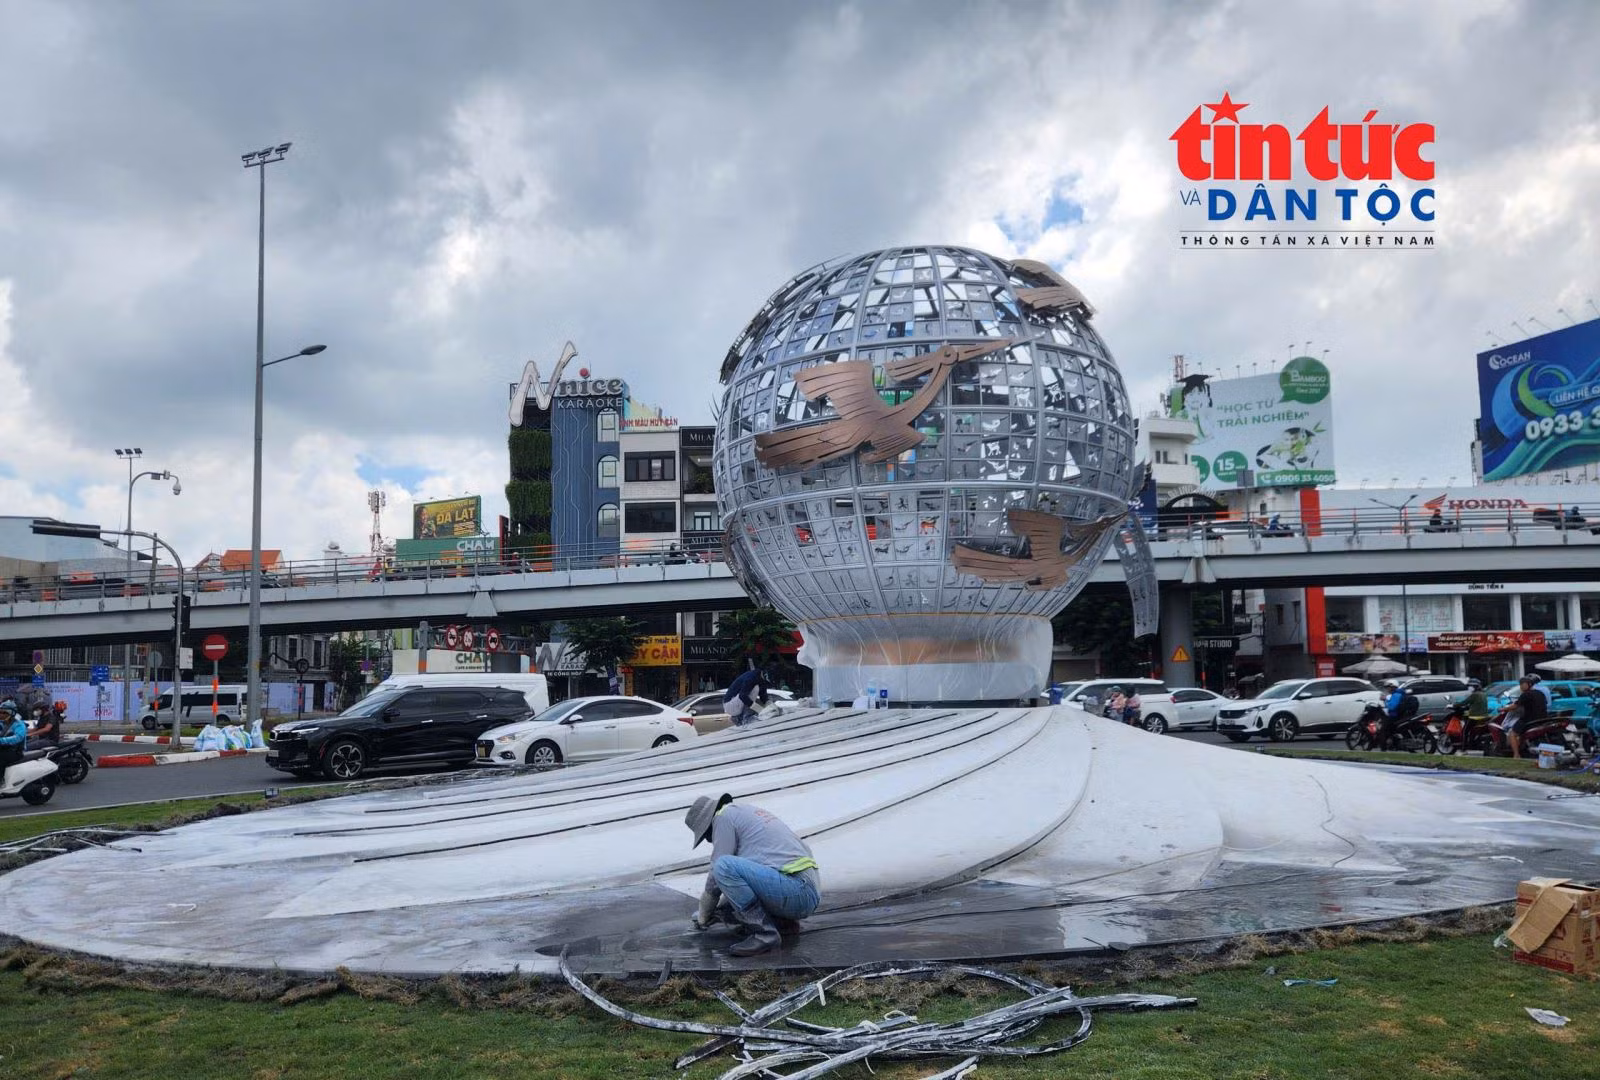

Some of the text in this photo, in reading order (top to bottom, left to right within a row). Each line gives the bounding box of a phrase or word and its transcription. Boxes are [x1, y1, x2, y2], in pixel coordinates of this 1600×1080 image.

[1500, 351, 1531, 367] OCEAN
[556, 397, 625, 410] KARAOKE
[1525, 410, 1584, 441] 0933
[1217, 458, 1235, 471] 15
[1448, 499, 1529, 511] HONDA
[1209, 639, 1232, 648] STUDIO
